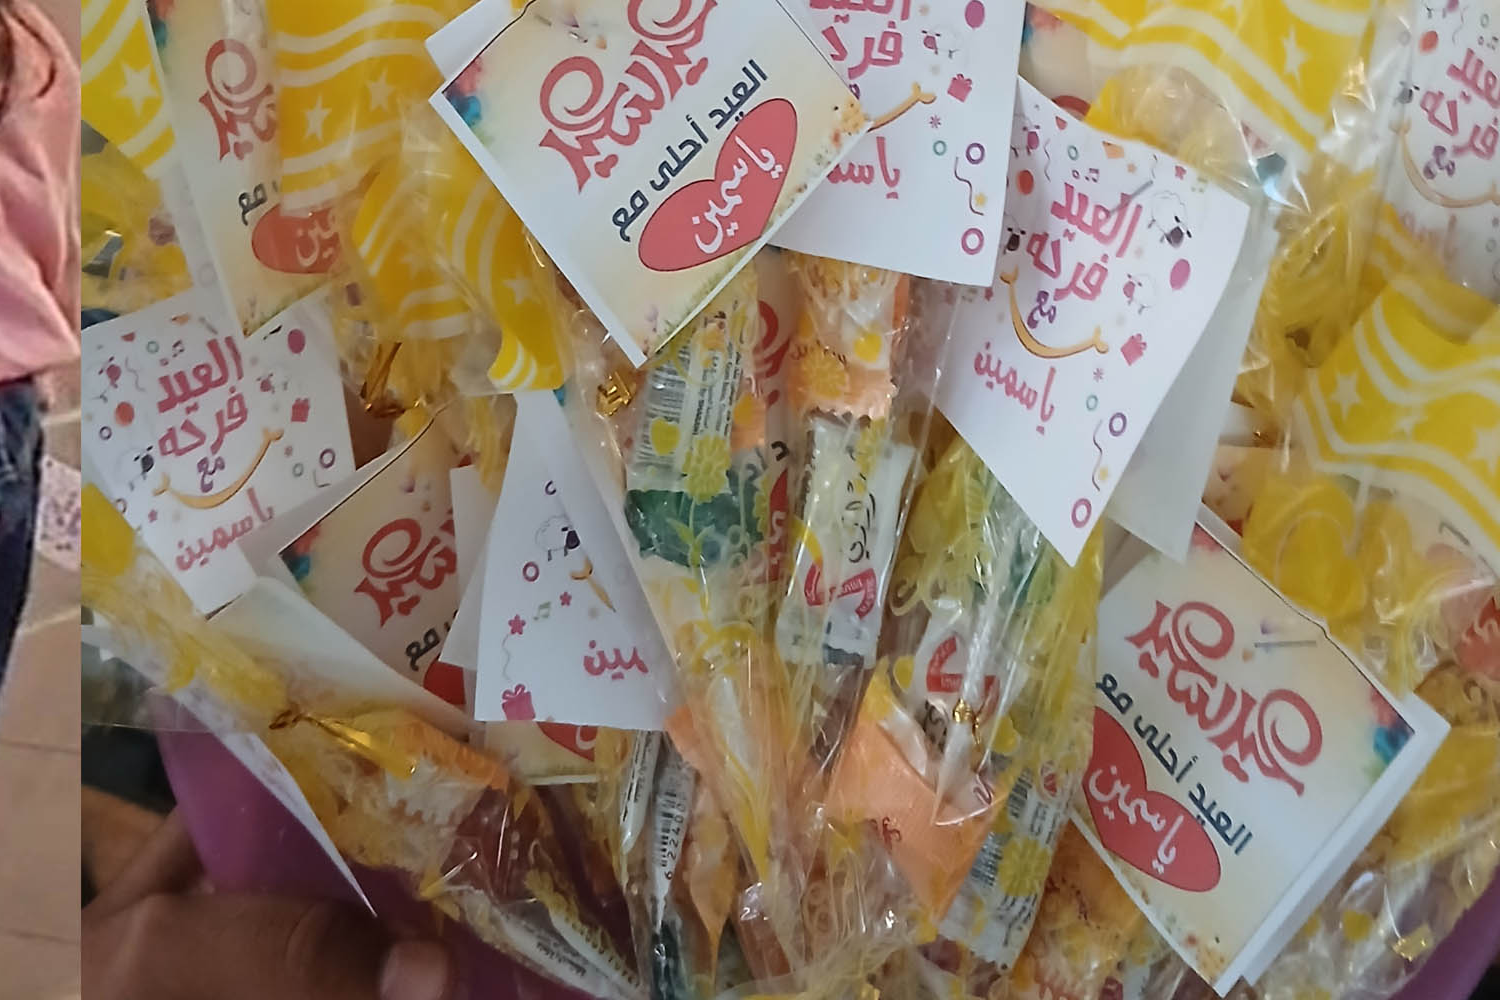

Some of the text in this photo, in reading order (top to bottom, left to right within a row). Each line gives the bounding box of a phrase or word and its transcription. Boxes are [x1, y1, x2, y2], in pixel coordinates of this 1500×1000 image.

[612, 59, 768, 242] العيد أحلى مع
[692, 135, 784, 254] ياسمين
[1050, 182, 1143, 258] العيد
[1027, 290, 1057, 329] مع
[157, 336, 244, 415] العيد
[973, 341, 1057, 435] ياسمين
[197, 456, 225, 493] مع
[175, 487, 274, 571] ياسمين
[1134, 715, 1198, 783] أحلى
[1088, 765, 1184, 874] ياسمين
[1188, 783, 1252, 855] العيد
